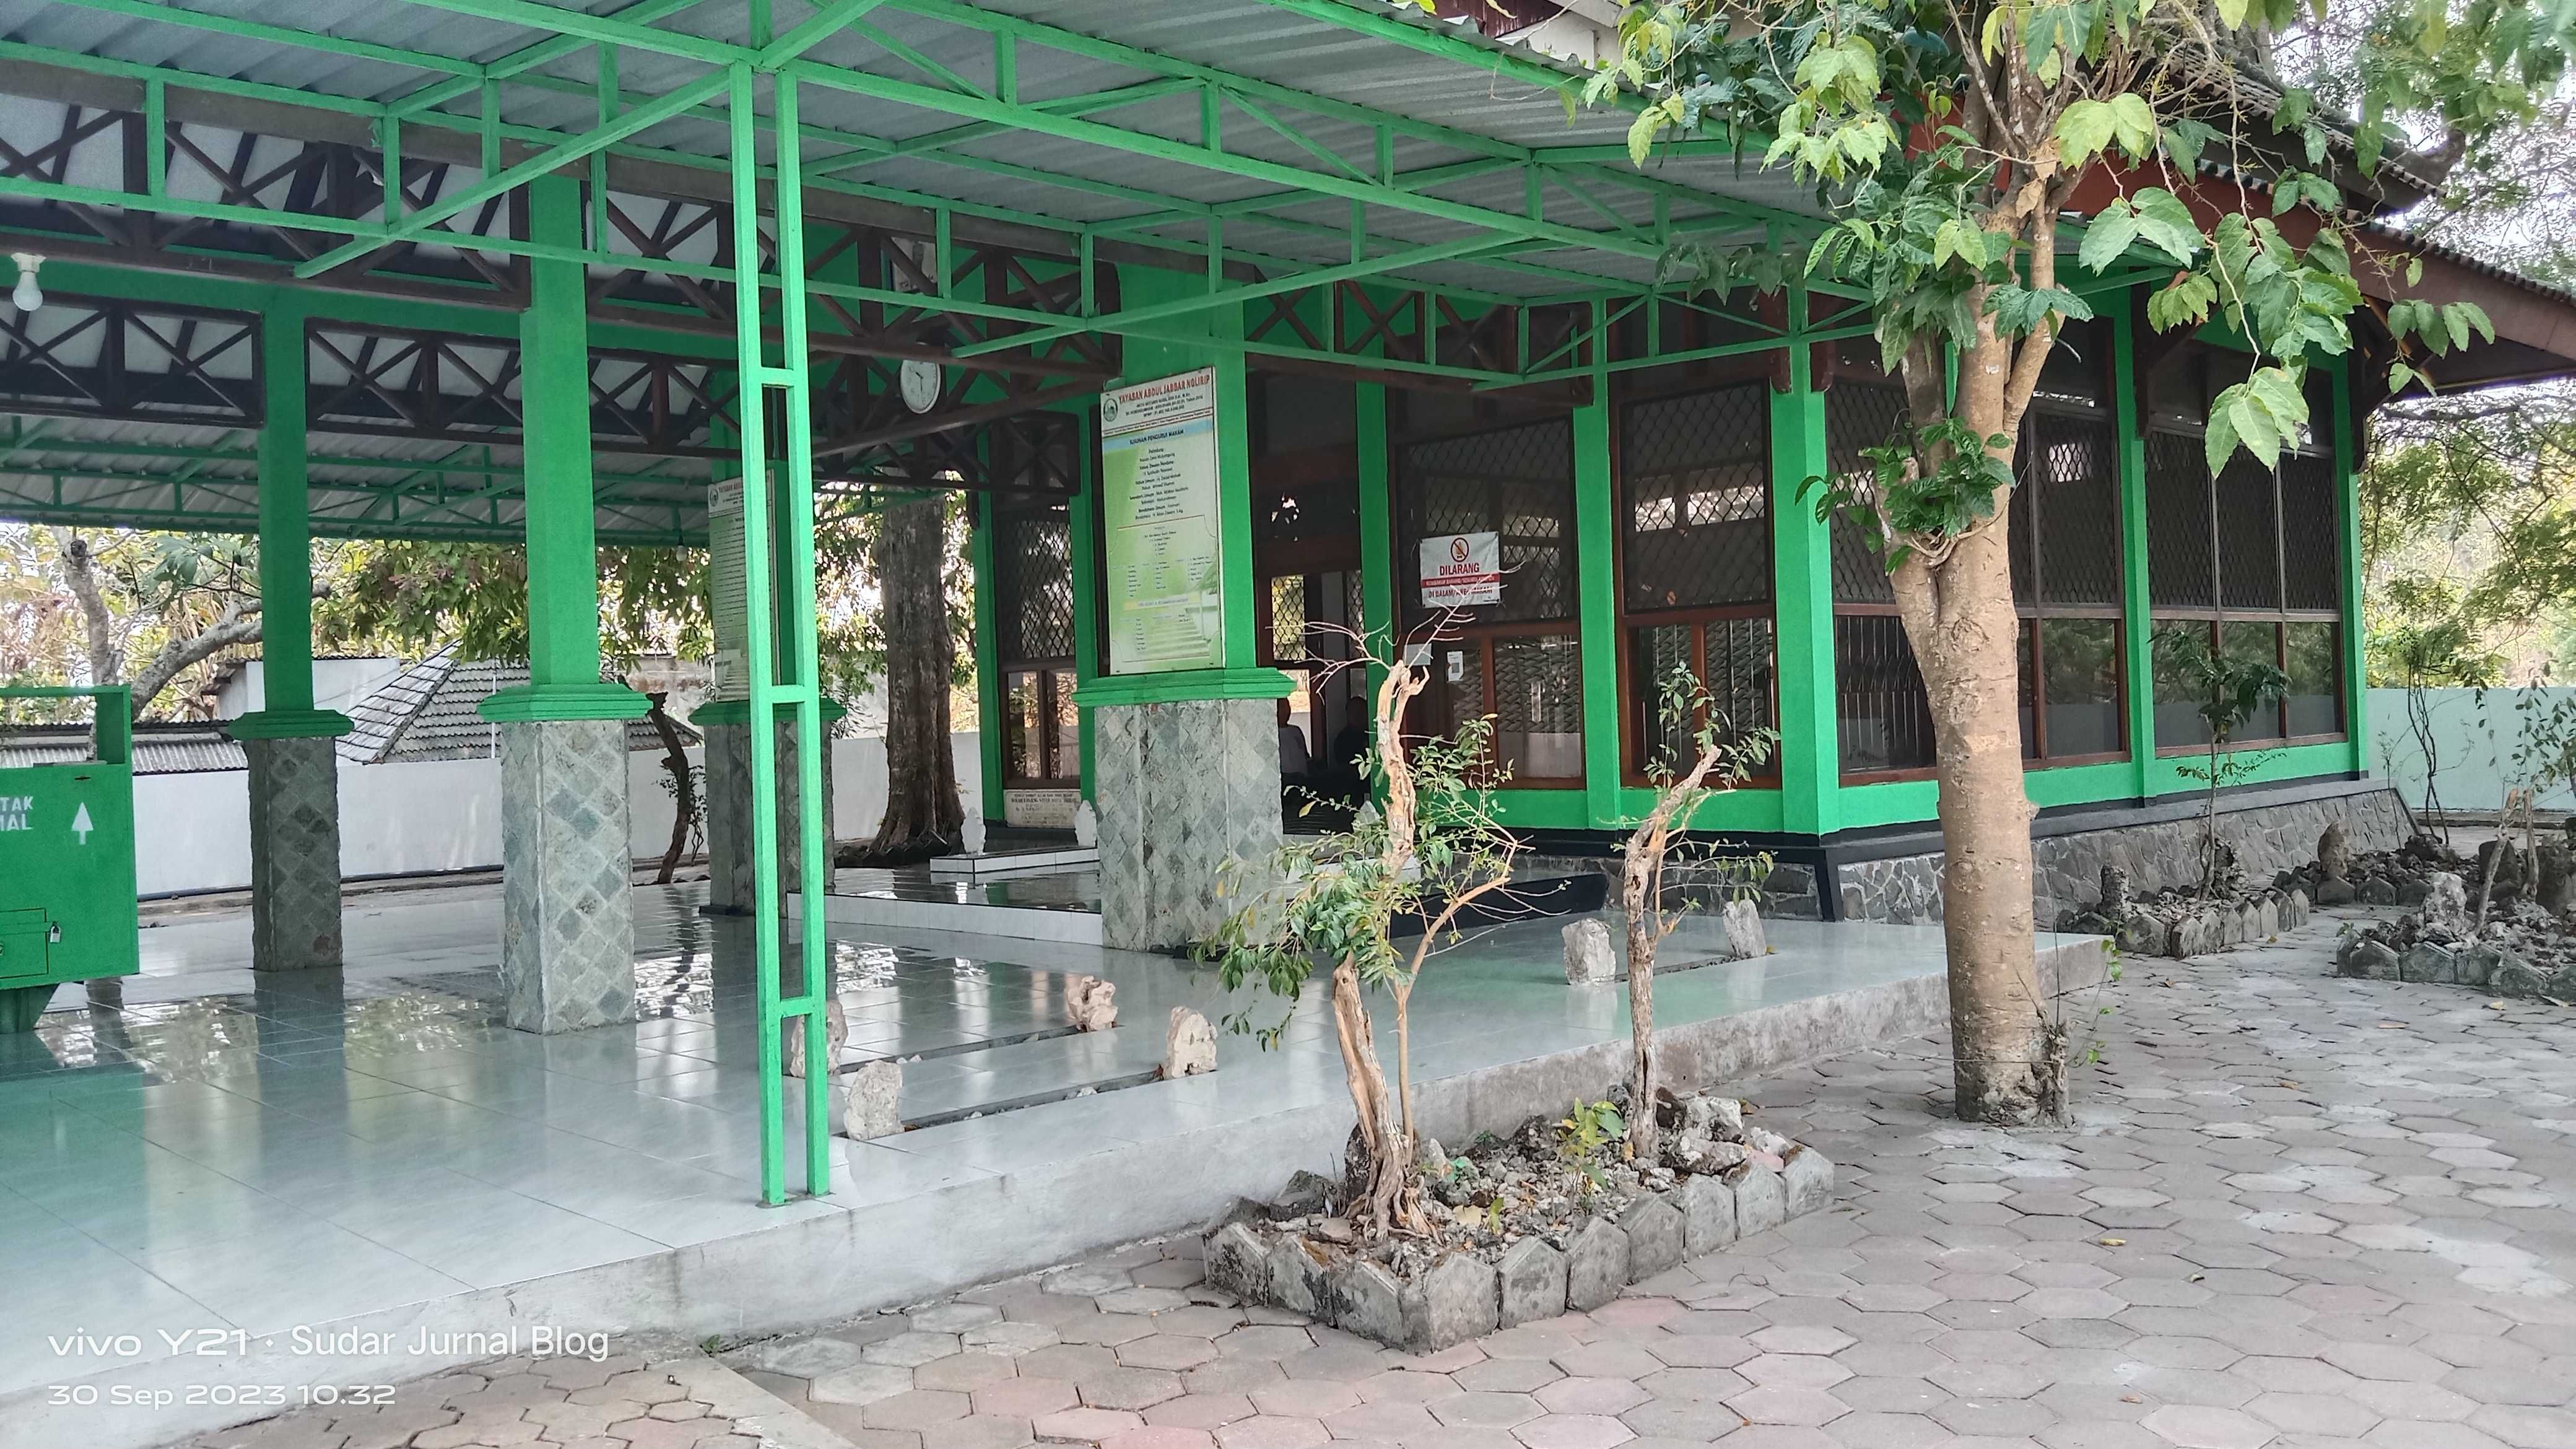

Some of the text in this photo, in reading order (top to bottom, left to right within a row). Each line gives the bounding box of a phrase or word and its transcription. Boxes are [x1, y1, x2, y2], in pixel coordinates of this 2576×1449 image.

[1119, 391, 1144, 404] YAYASAN
[1144, 386, 1162, 398] ABDUL
[1164, 381, 1185, 394] JABBAR
[1186, 375, 1210, 388] NGLIRIP
[1440, 563, 1479, 575] DILARANG
